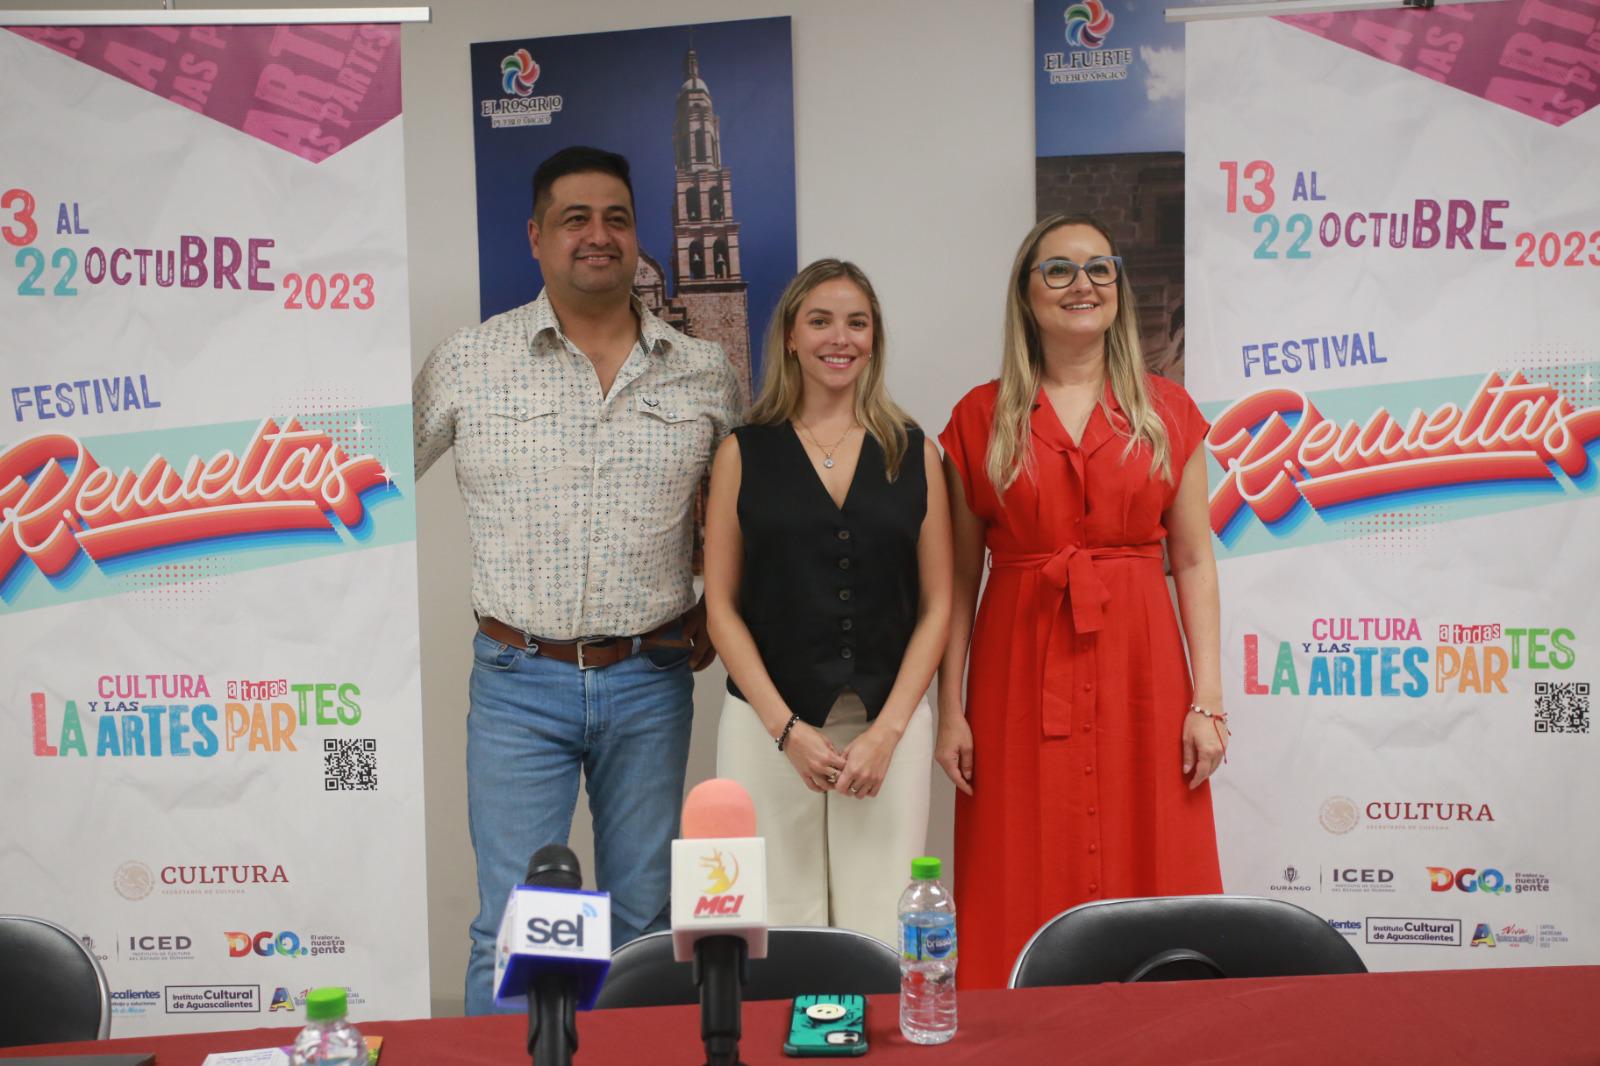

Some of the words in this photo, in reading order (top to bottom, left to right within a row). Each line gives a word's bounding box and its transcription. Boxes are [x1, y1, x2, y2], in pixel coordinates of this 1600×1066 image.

[1046, 54, 1068, 70] EL
[1071, 49, 1132, 68] FUERTE
[1219, 160, 1276, 214] 13
[1292, 171, 1326, 201] AL
[56, 202, 90, 235] AL
[1252, 213, 1313, 259] 22
[1514, 230, 1600, 268] 2023
[15, 247, 78, 296] 22
[282, 272, 375, 310] 2023
[1242, 331, 1388, 378] FESTIVAL
[11, 374, 162, 422] FESTIVAL
[1311, 617, 1422, 641] CULTURA
[1453, 623, 1501, 644] todas
[1302, 643, 1311, 653] Y
[1317, 643, 1351, 653] LAS
[1244, 633, 1300, 696] LA
[1308, 646, 1429, 698] ARTES
[98, 675, 211, 699] CULTURA
[241, 679, 288, 701] todas
[88, 702, 98, 712] Y
[104, 701, 139, 712] LAS
[30, 692, 88, 757] LA
[96, 704, 219, 758] ARTES
[1366, 802, 1495, 822] CULTURA
[160, 864, 290, 885] CULTURA
[1333, 869, 1394, 882] ICED
[1515, 884, 1550, 893] gente
[694, 895, 744, 915] MCI
[526, 914, 584, 947] sel
[1386, 932, 1454, 942] Aguascalientes
[1404, 922, 1454, 933] Cultural
[129, 936, 192, 951] ICED
[310, 946, 346, 956] gente
[173, 1001, 184, 1009] de
[186, 1000, 253, 1010] Aguascalientes
[204, 990, 253, 1000] Cultural
